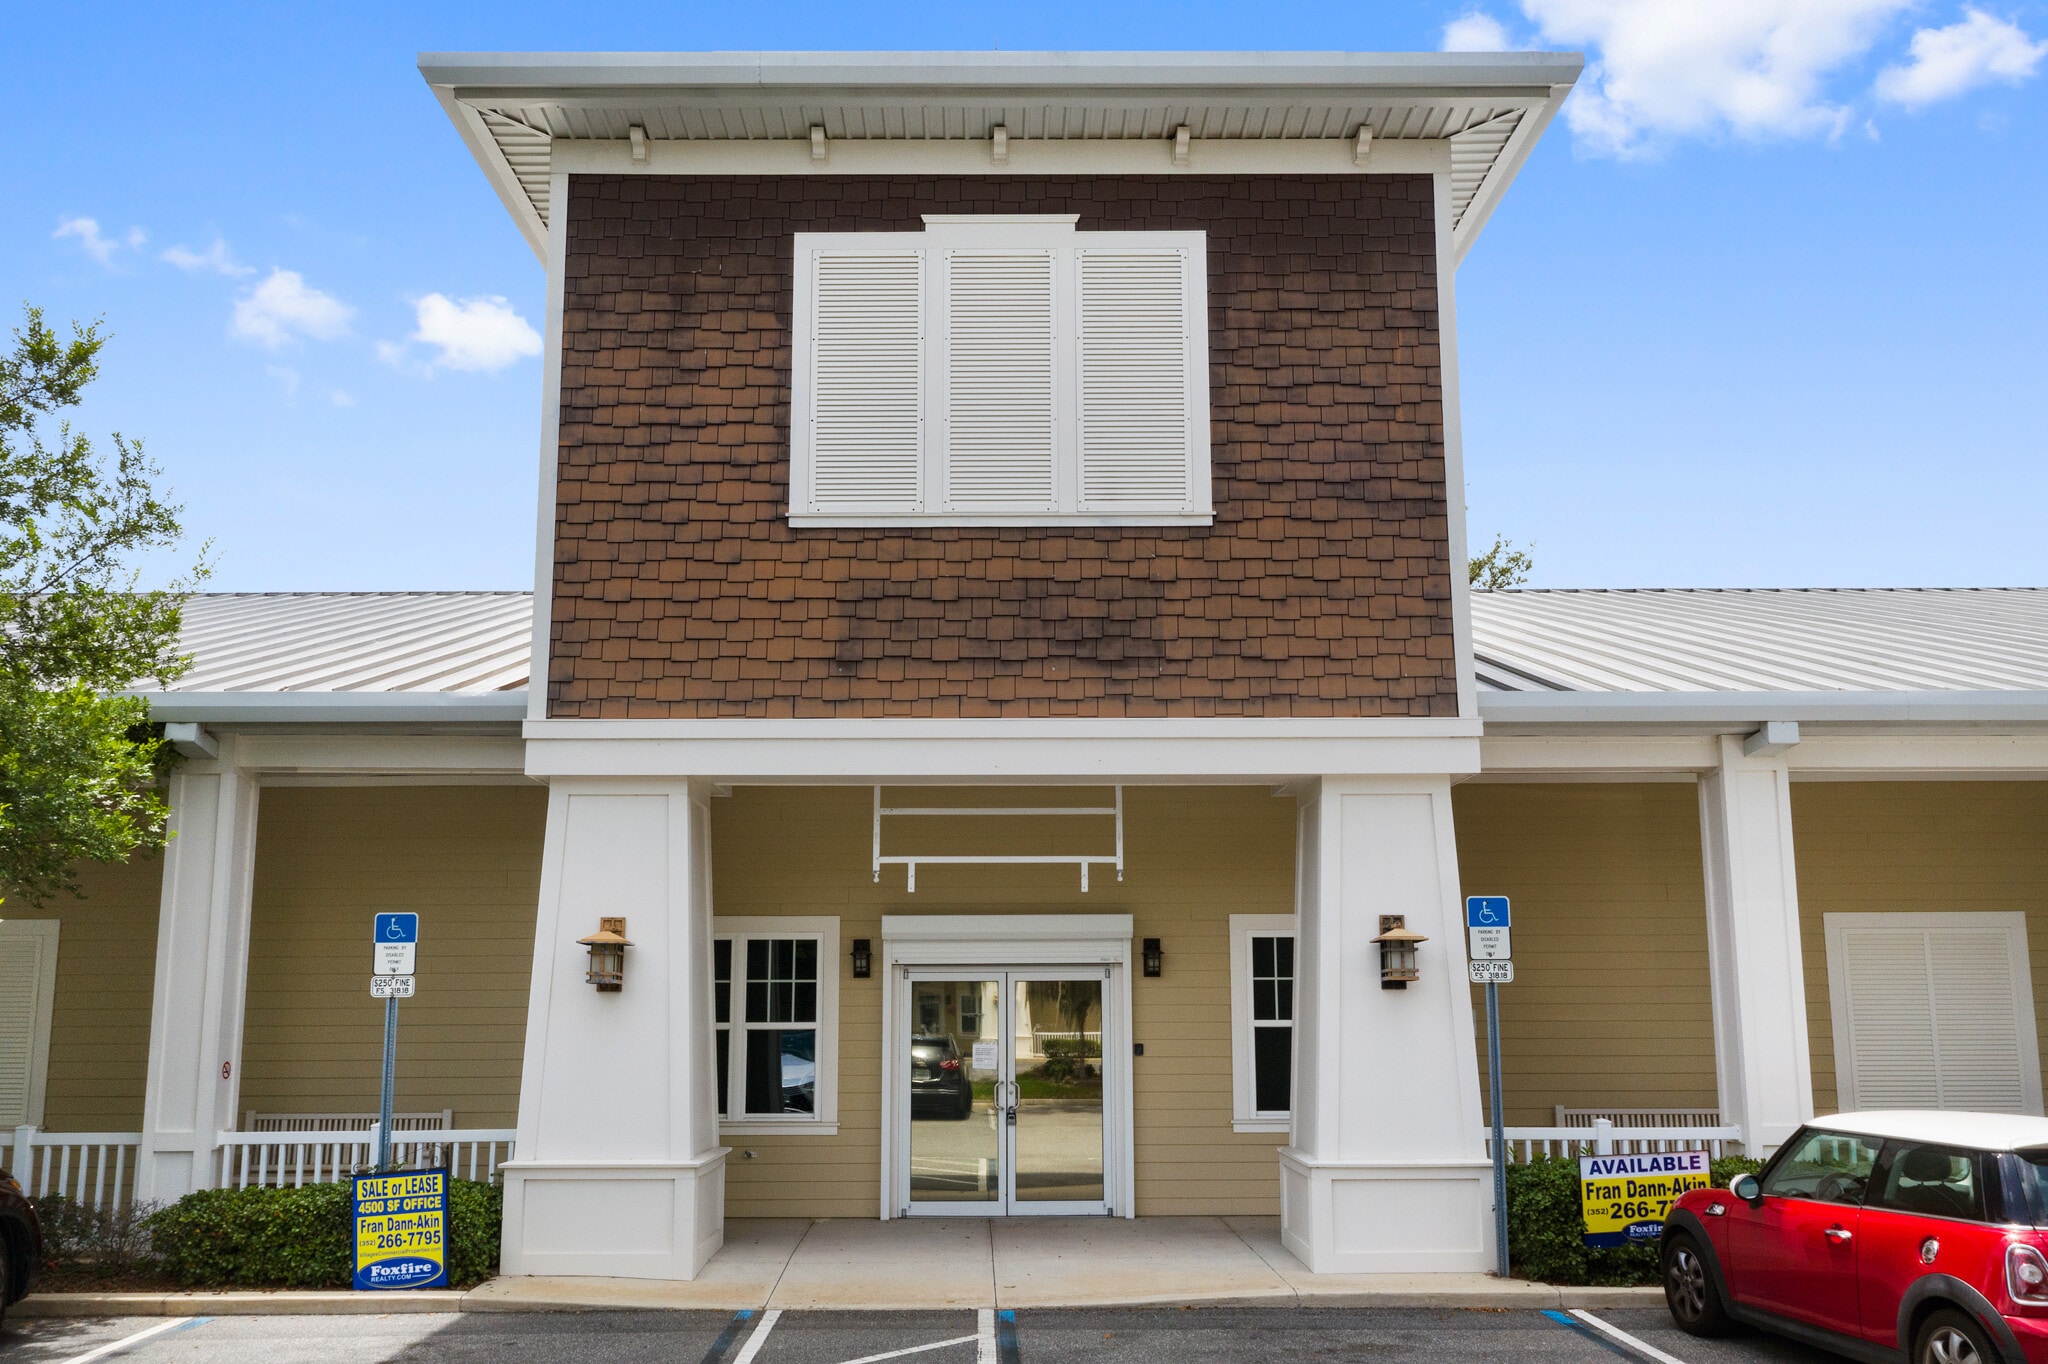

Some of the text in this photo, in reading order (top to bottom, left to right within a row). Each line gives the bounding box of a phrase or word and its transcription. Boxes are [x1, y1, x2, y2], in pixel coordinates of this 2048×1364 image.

[1472, 963, 1508, 972] $250 FINE
[374, 979, 410, 987] $250 FINE
[1589, 1155, 1701, 1175] AVAILABLE
[361, 1176, 438, 1198] SALE or LEASE
[1585, 1182, 1621, 1201] Fran
[358, 1196, 441, 1214] 4500 SF OFFICE
[1587, 1200, 1675, 1220] (352) 266-7
[361, 1214, 440, 1233] Fran Dann-Akin
[1629, 1224, 1663, 1233] Foxfir
[377, 1230, 441, 1249] 266-7795
[370, 1262, 432, 1277] Foxfire
[370, 1273, 412, 1282] REALTY.COM
